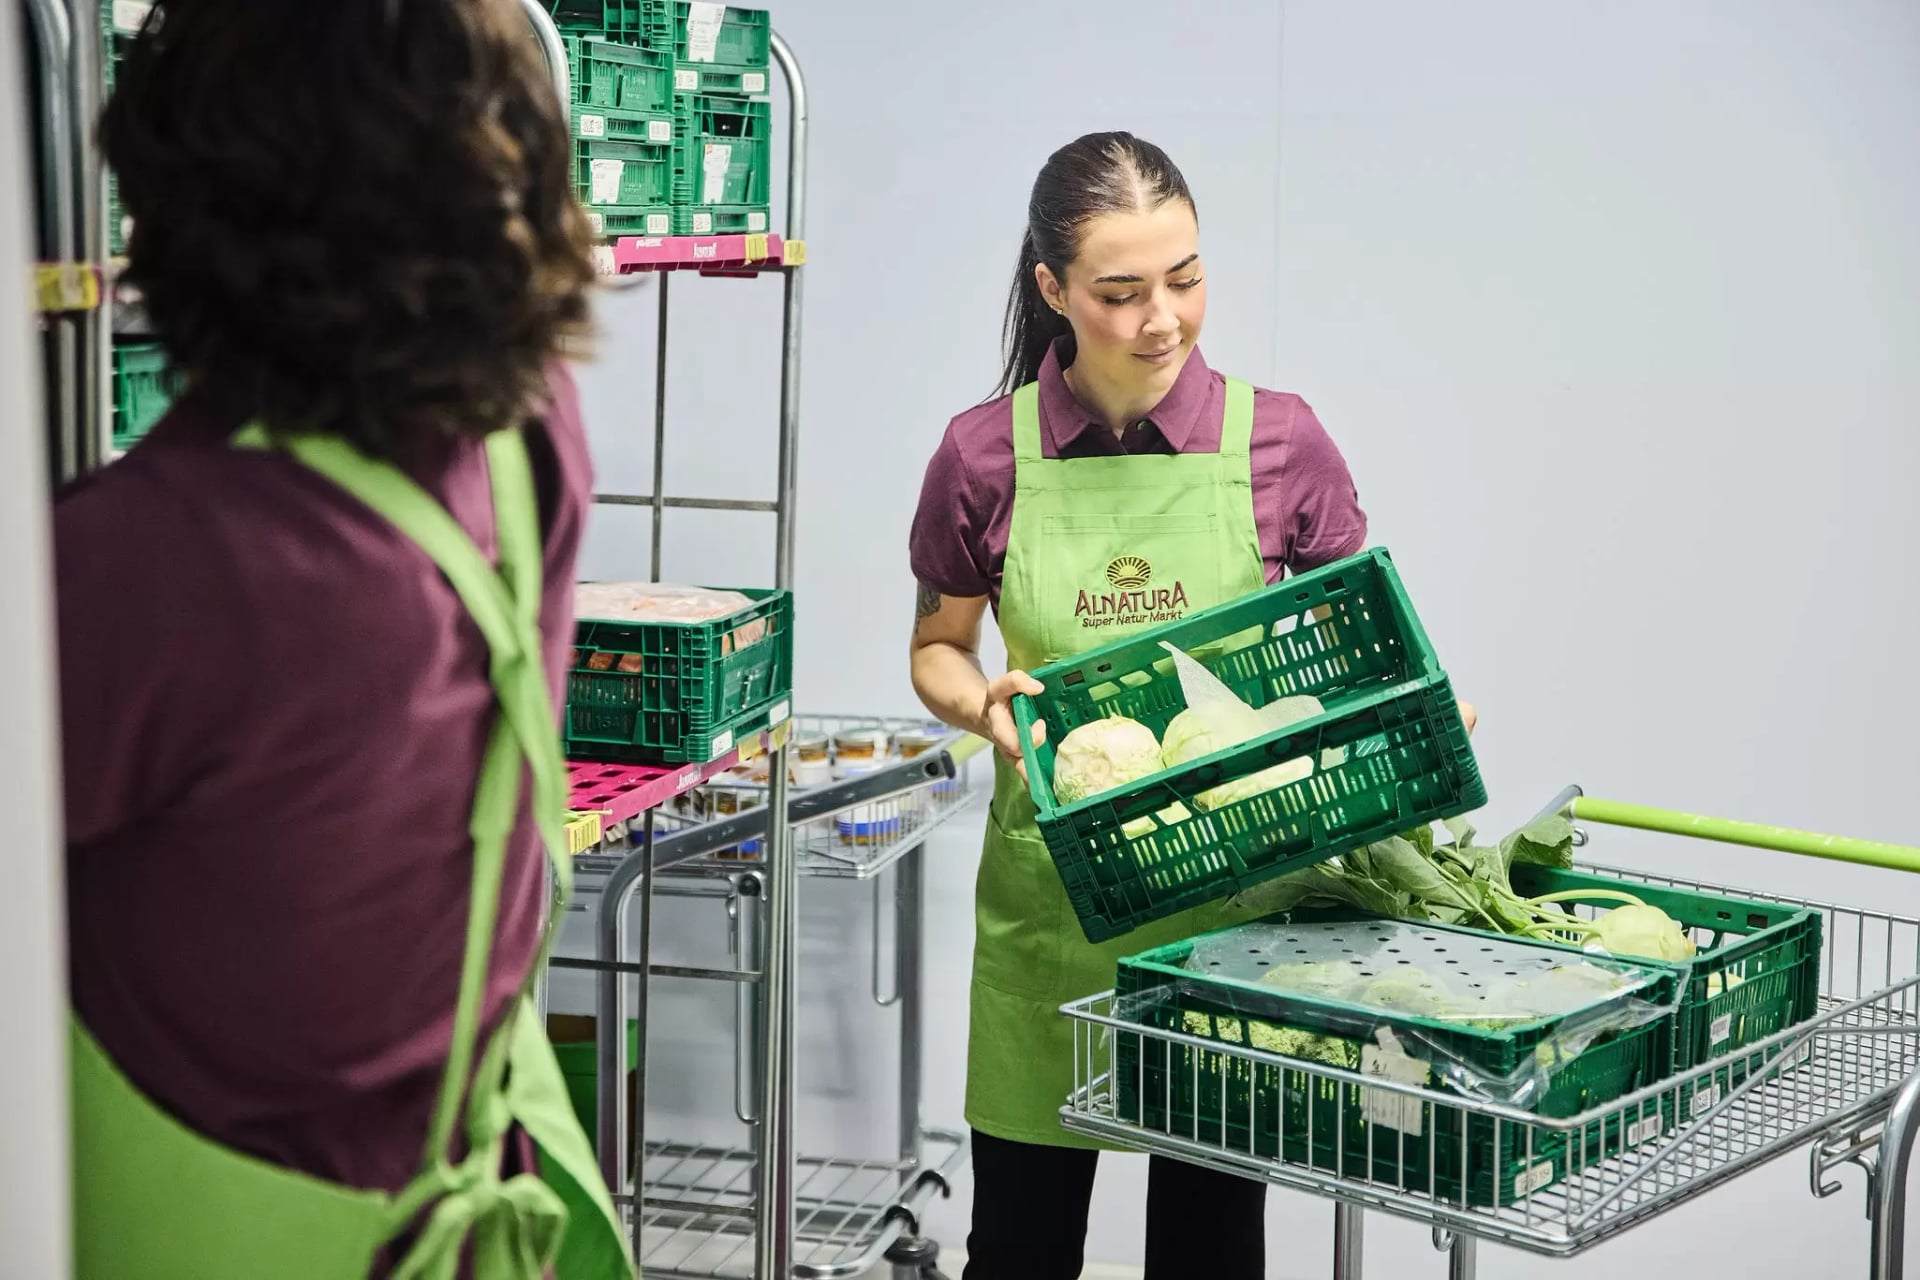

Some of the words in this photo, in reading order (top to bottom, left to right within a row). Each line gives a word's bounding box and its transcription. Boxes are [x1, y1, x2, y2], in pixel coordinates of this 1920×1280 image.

[1074, 580, 1189, 616] ALNATURA
[1082, 616, 1114, 629] Super
[1116, 614, 1147, 626] Natur
[1149, 610, 1182, 623] Markt
